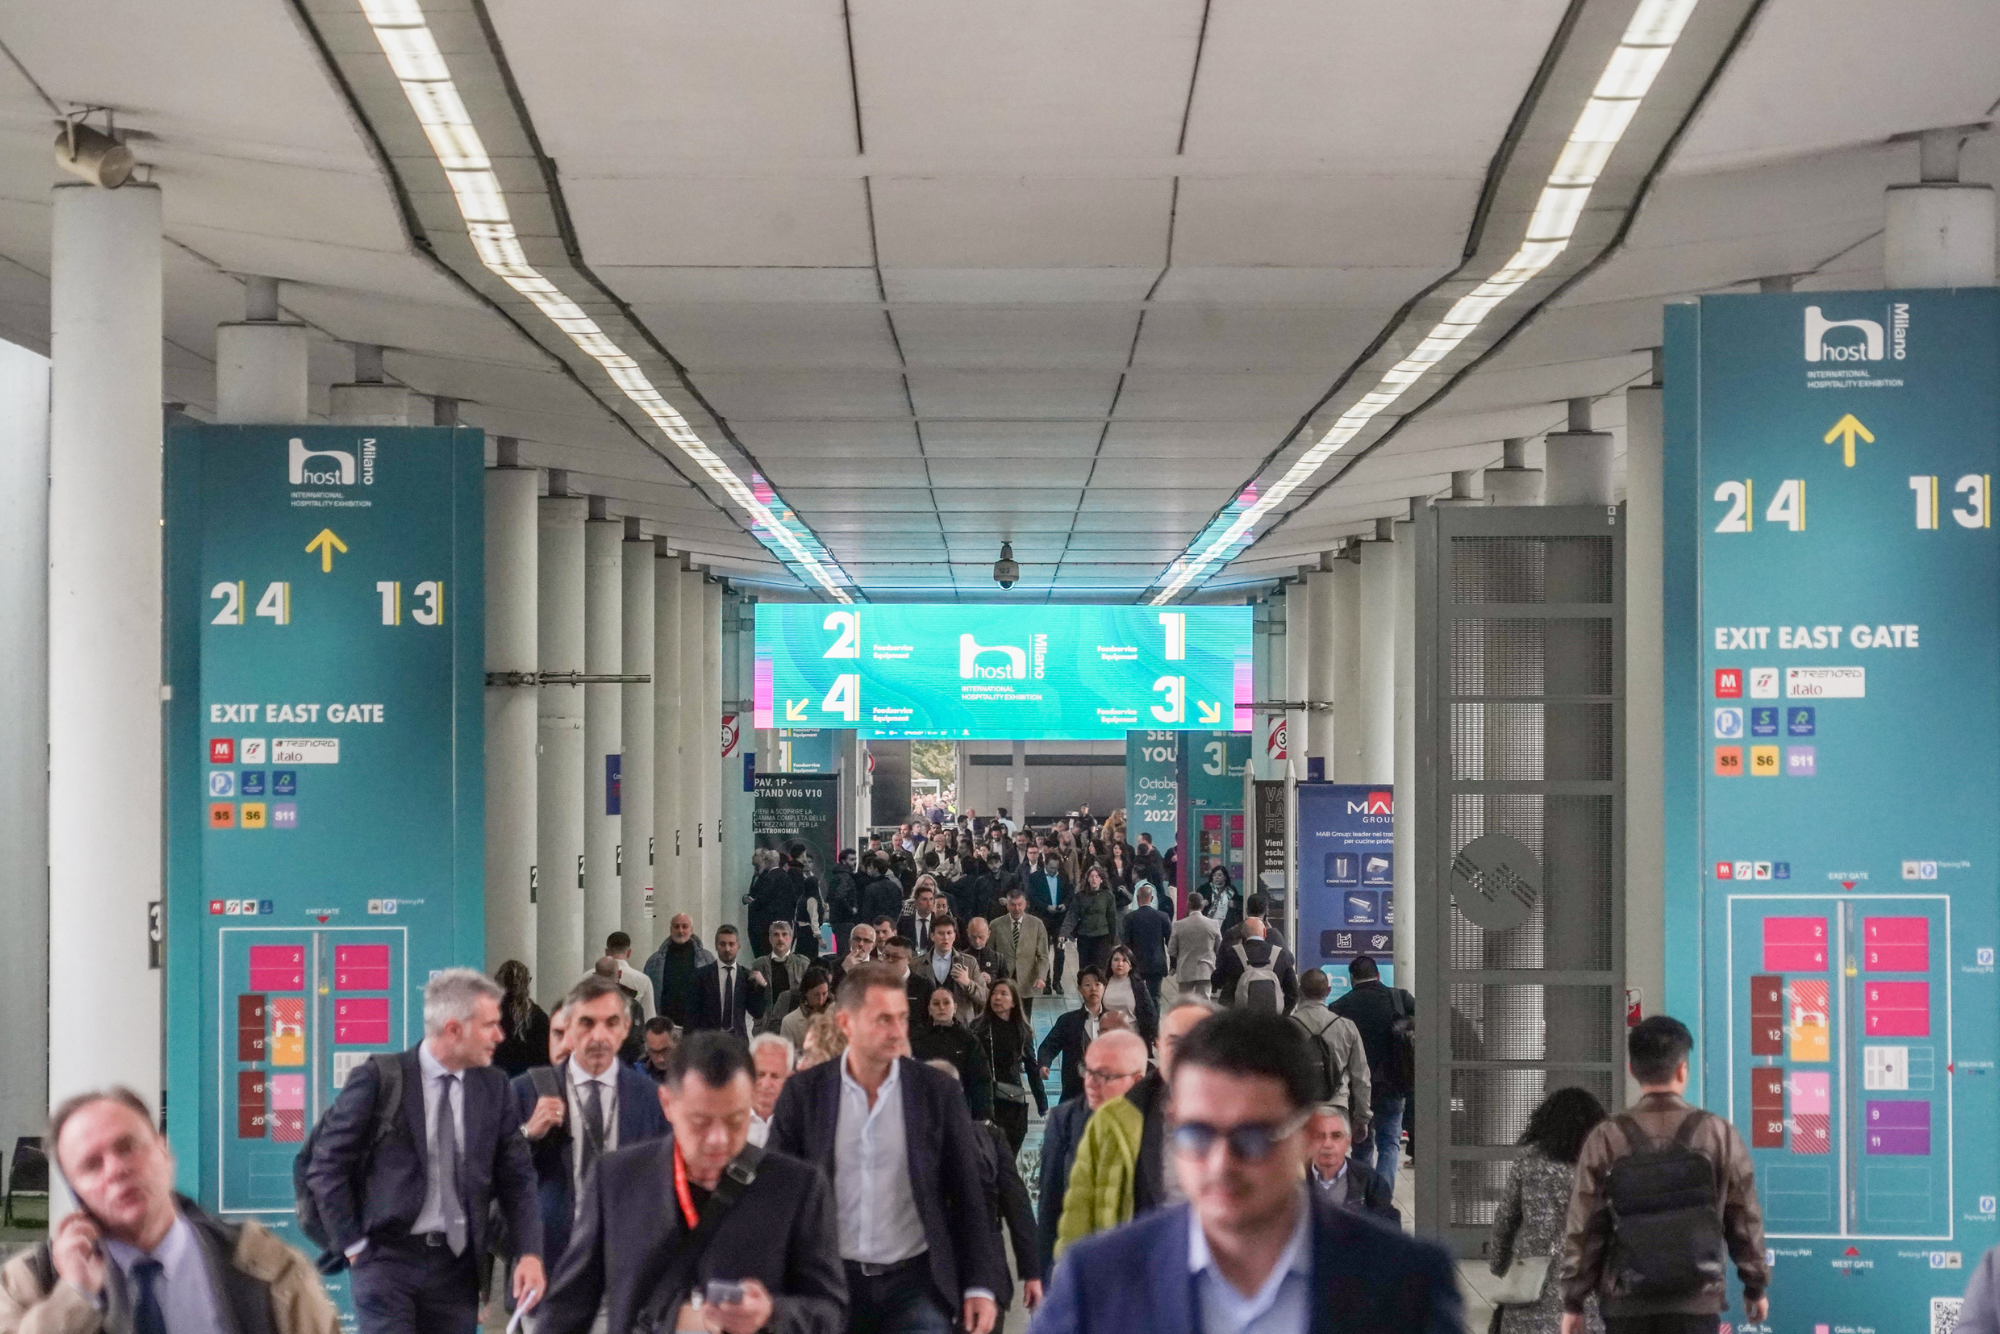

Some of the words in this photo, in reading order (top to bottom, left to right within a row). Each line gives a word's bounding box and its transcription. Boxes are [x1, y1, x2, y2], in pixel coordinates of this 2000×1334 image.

[1894, 303, 1909, 360] Milano
[1822, 343, 1867, 361] host
[1807, 370, 1870, 378] INTERNATIONAL
[1807, 380, 1857, 388] HOSPITALITY
[1859, 379, 1903, 387] EXHIBITION
[363, 438, 376, 485] Milano
[304, 468, 341, 485] host
[1714, 480, 1746, 532] 2
[1766, 479, 1800, 531] 4
[1909, 476, 1931, 530] 1
[1952, 474, 1984, 528] 3
[210, 582, 238, 625] 2
[255, 582, 284, 625] 4
[376, 581, 394, 625] 1
[412, 581, 438, 626] 3
[822, 612, 855, 658] 2
[1158, 612, 1179, 660] 1
[1715, 627, 1770, 650] EXIT
[1778, 626, 1842, 649] EAST
[1850, 625, 1920, 648] GATE
[1034, 634, 1048, 679] Milano
[1101, 653, 1138, 661] Equipment
[974, 664, 1012, 679] host
[1720, 674, 1736, 688] M
[822, 674, 854, 722] 4
[1150, 676, 1179, 723] 3
[210, 704, 258, 722] EXIT
[266, 704, 320, 722] EAST
[326, 704, 384, 723] GATE
[872, 715, 910, 723] Equipment
[1101, 716, 1138, 724] Equipment
[214, 743, 229, 754] M
[1141, 747, 1176, 762] YOU
[1202, 742, 1222, 776] 3
[1721, 756, 1738, 766] S5
[1756, 756, 1774, 766] S6
[1790, 756, 1814, 766] S11
[1140, 776, 1177, 789] Octobe
[754, 789, 784, 798] STAND
[786, 789, 802, 798] V06
[806, 789, 822, 798] V10
[1167, 794, 1176, 805] 2
[214, 811, 230, 820] S5
[246, 811, 260, 820] S6
[274, 811, 294, 821] S11
[1144, 810, 1176, 822] 2027
[1815, 927, 1822, 936] 2
[1872, 927, 1876, 936] 1
[293, 954, 299, 962] 2
[1815, 953, 1822, 963] 4
[1872, 953, 1878, 963] 3
[340, 975, 346, 983] 3
[1771, 992, 1778, 1002] 8
[1872, 991, 1878, 1000] 5
[255, 1008, 261, 1016] 8
[340, 1006, 346, 1015] 5
[1872, 1018, 1878, 1026] 7
[1769, 1030, 1781, 1041] 12
[253, 1040, 263, 1048] 12
[253, 1085, 263, 1093] 16
[1769, 1084, 1781, 1094] 16
[1872, 1110, 1879, 1120] 9
[252, 1117, 264, 1125] 20
[1768, 1123, 1783, 1133] 20
[1872, 1137, 1881, 1147] 11
